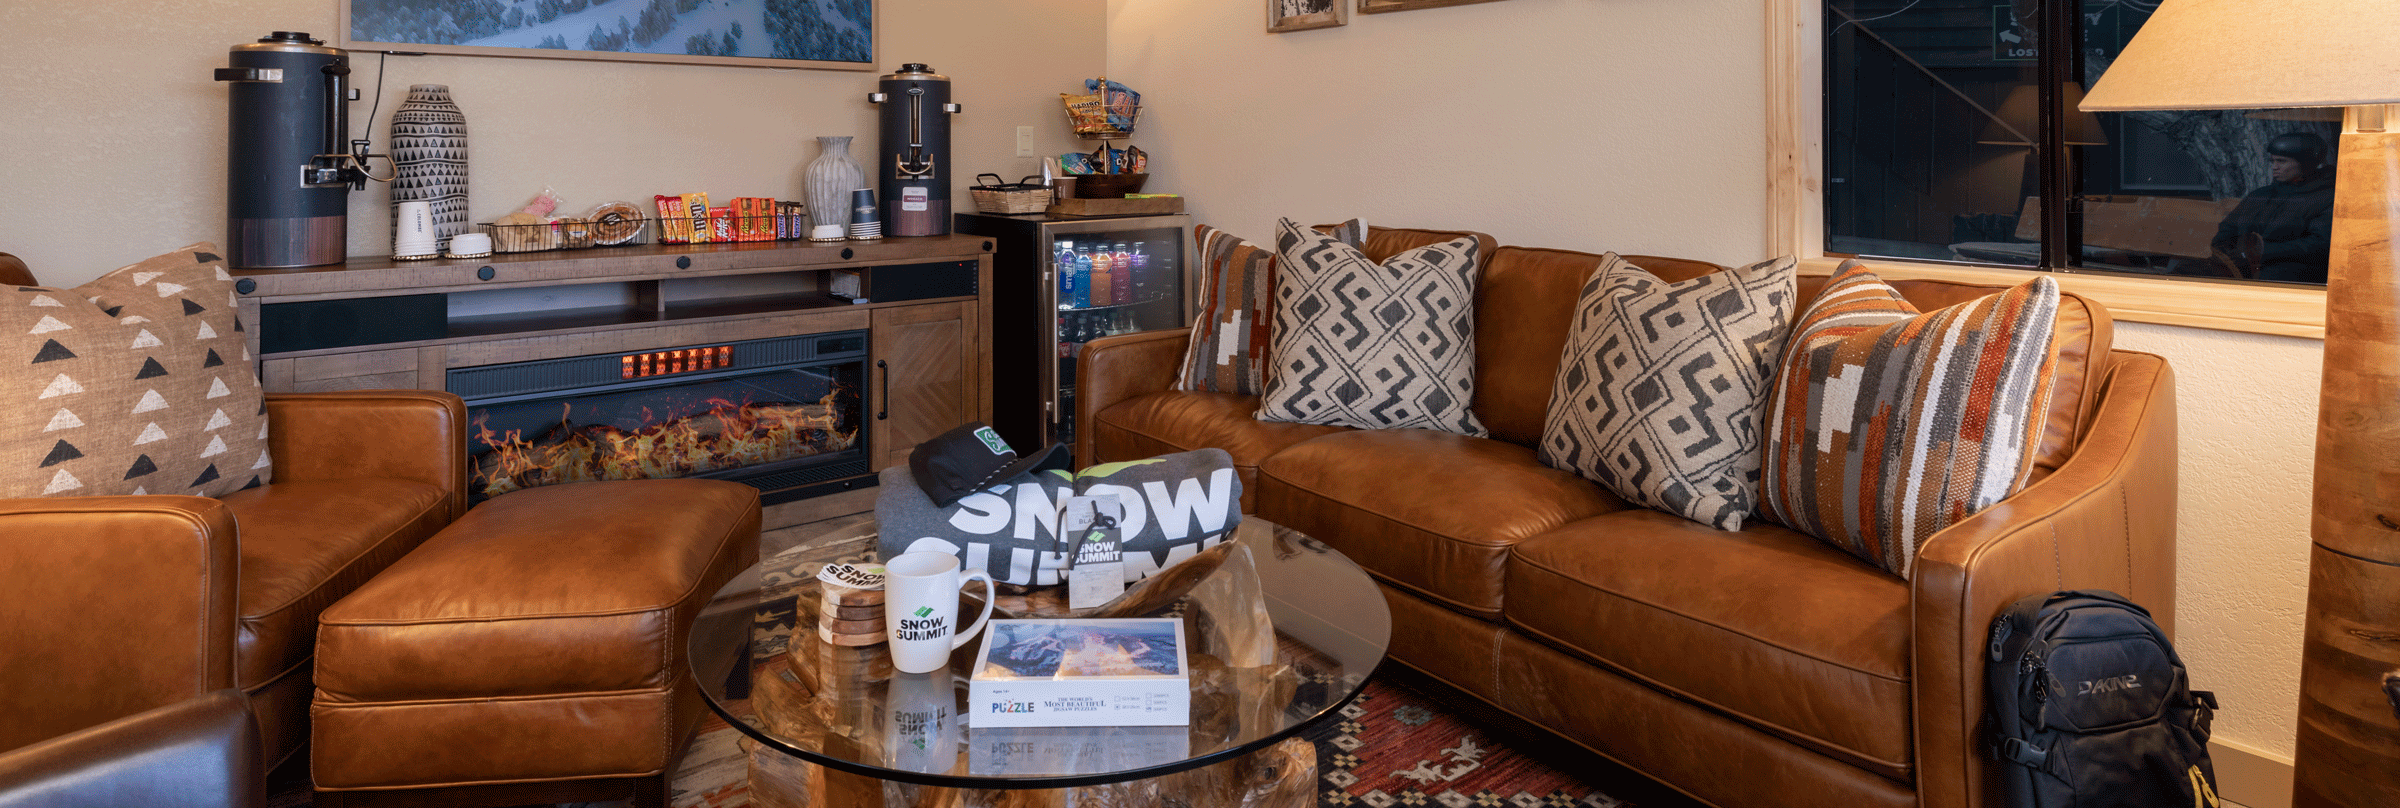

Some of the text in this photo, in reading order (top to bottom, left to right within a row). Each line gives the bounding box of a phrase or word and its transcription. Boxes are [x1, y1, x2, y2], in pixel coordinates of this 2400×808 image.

[949, 468, 1233, 543] SNOW
[1080, 541, 1115, 554] SNOW
[826, 565, 885, 586] SUMMI
[900, 616, 944, 631] SNOW
[896, 625, 948, 641] SUMMIT
[2077, 674, 2142, 697] DAKINE
[992, 701, 1035, 713] PUZZLE
